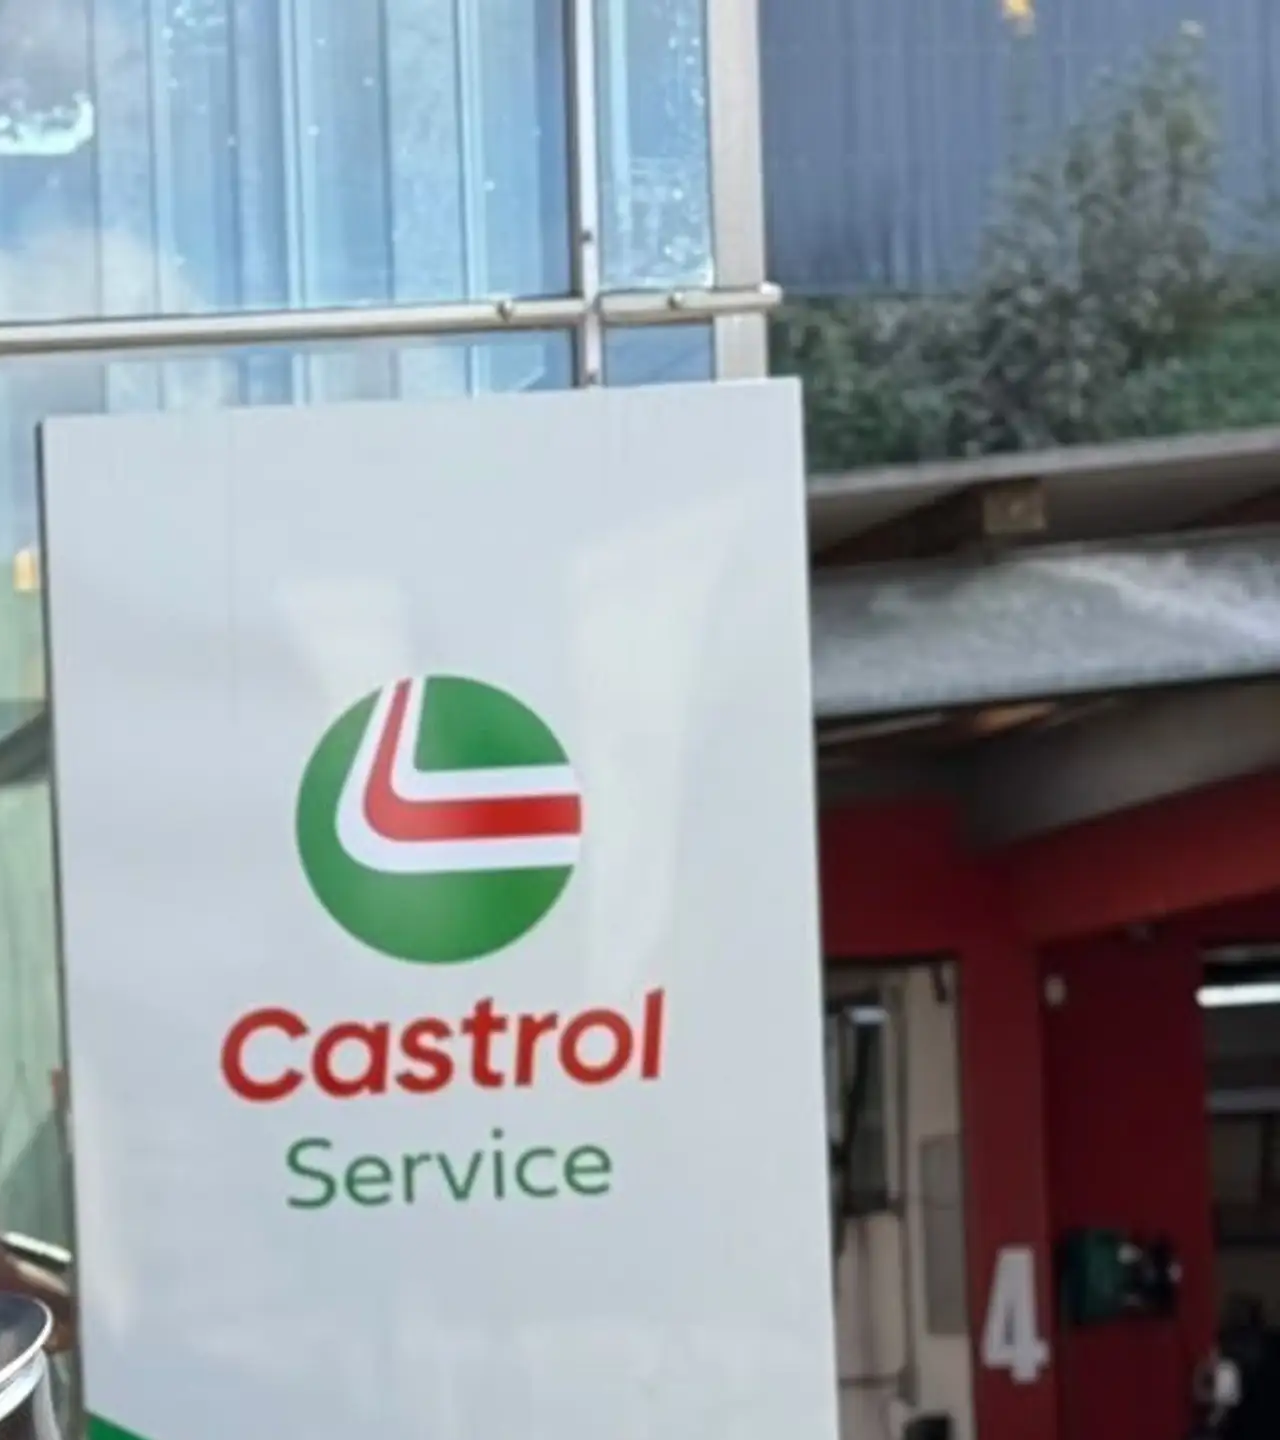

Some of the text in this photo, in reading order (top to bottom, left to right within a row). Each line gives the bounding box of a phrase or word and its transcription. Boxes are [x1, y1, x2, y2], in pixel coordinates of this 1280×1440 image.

[221, 987, 664, 1103] Castrol
[285, 1127, 613, 1210] Service
[982, 1246, 1046, 1381] 4
